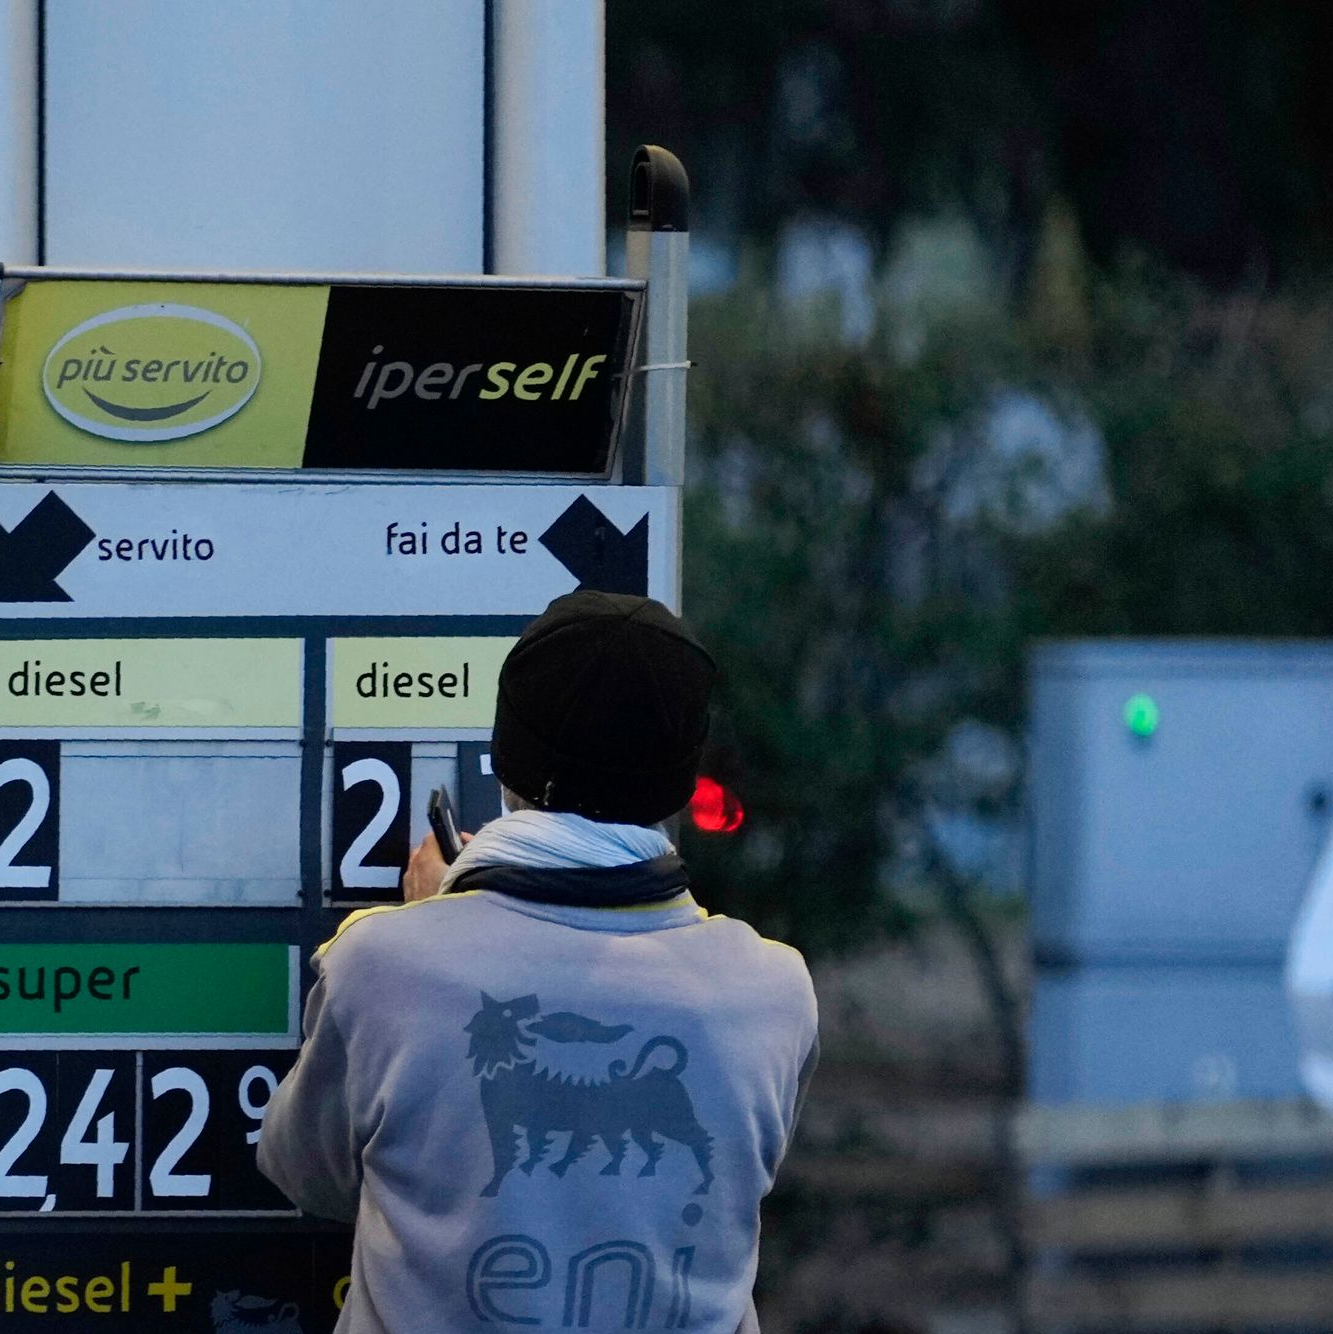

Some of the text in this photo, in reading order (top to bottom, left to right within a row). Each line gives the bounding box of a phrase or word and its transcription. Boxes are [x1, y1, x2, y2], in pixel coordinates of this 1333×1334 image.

[57, 345, 248, 389] più servito
[354, 345, 607, 410] iperself
[97, 529, 214, 561] servito
[386, 521, 528, 556] fai da te
[7, 661, 123, 698] diesel
[356, 661, 469, 698] diesel
[339, 757, 402, 888] 2
[466, 1203, 703, 1329] eni
